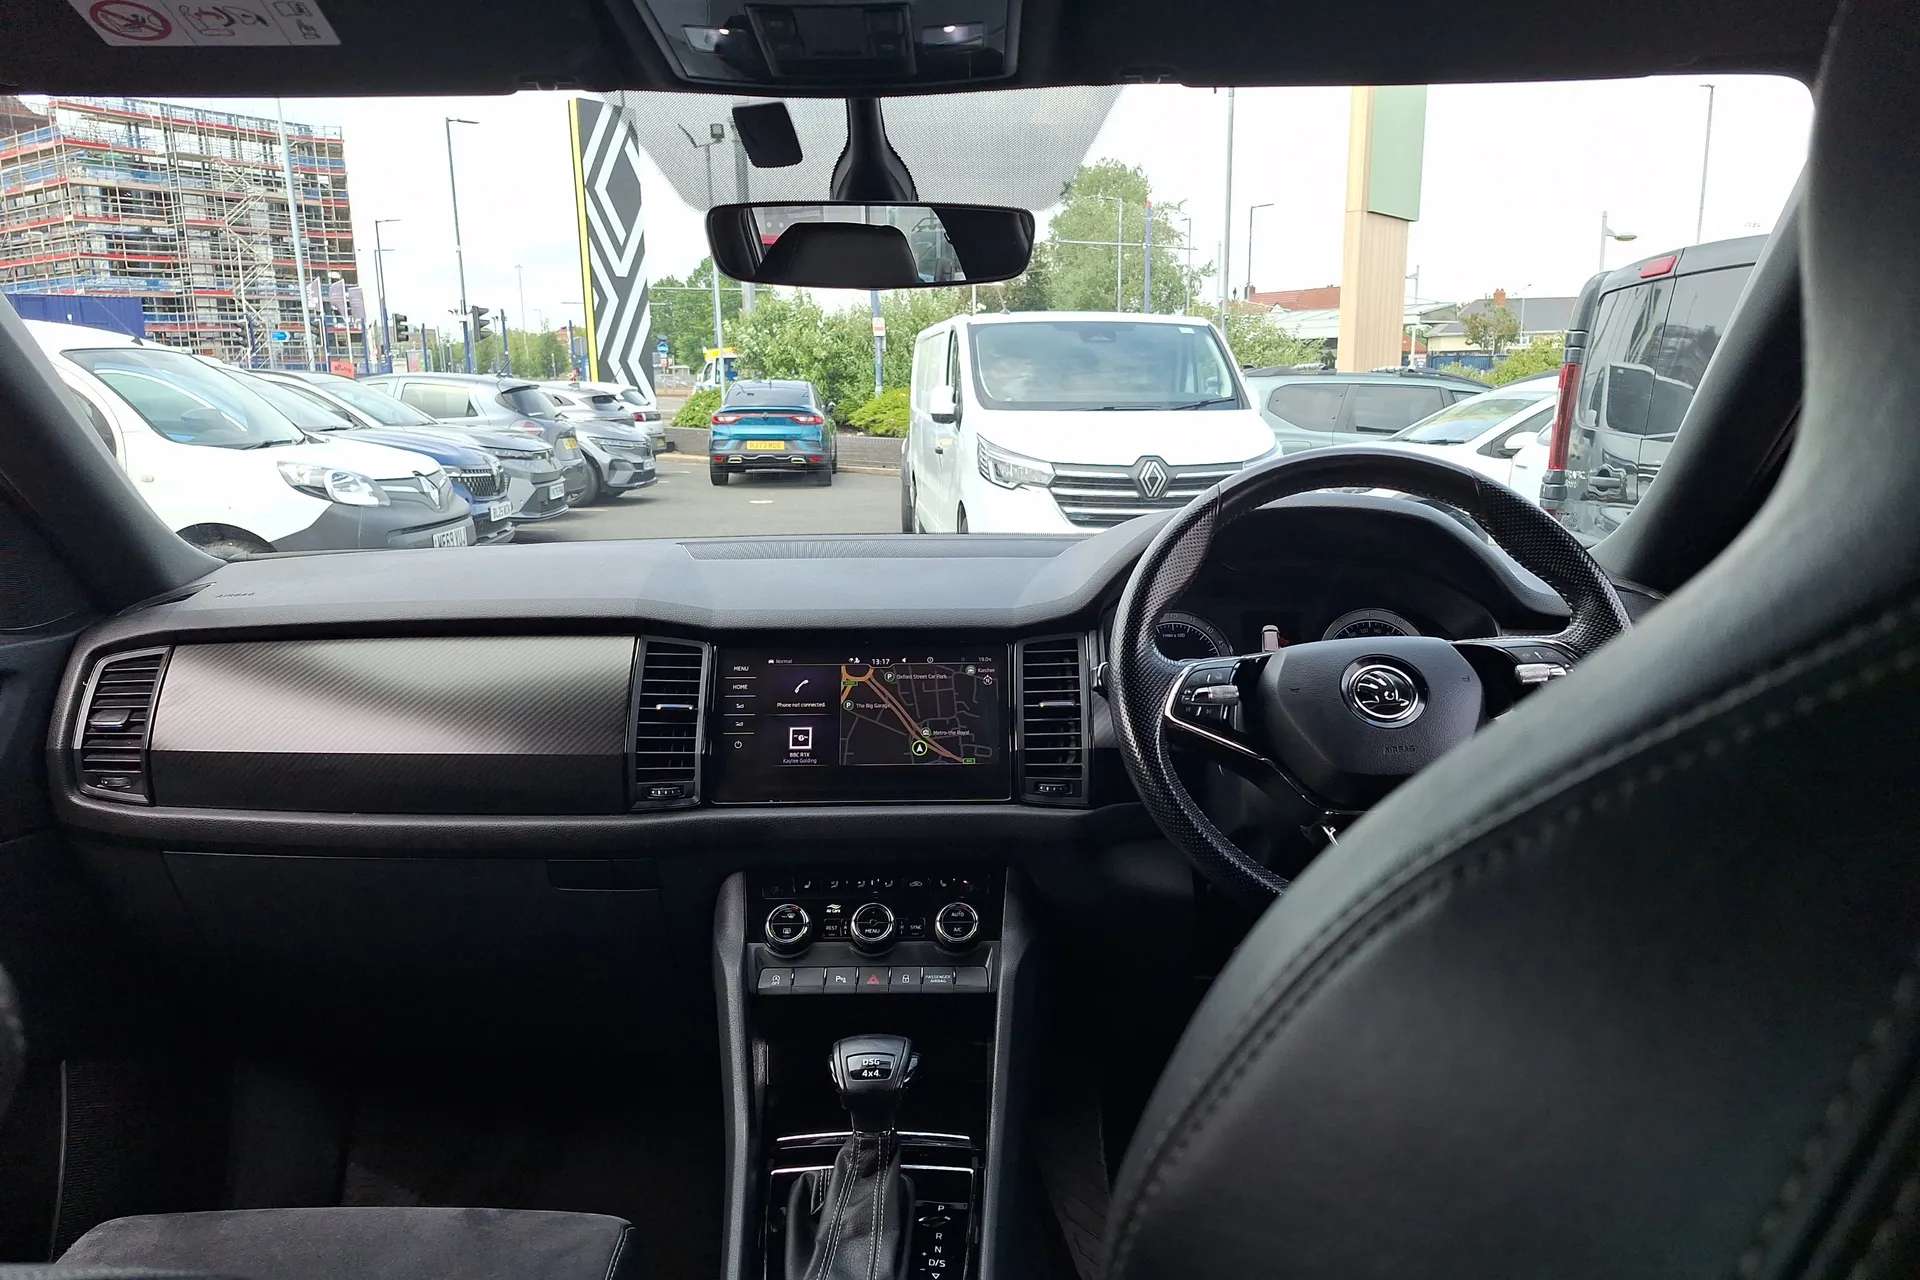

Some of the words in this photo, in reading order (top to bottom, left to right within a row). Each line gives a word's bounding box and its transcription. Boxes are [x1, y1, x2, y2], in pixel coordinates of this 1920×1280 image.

[871, 657, 890, 666] 13:17
[873, 702, 890, 711] Garage
[797, 757, 817, 765] Golding
[862, 1058, 880, 1066] DSG
[928, 1259, 946, 1268] D/S
